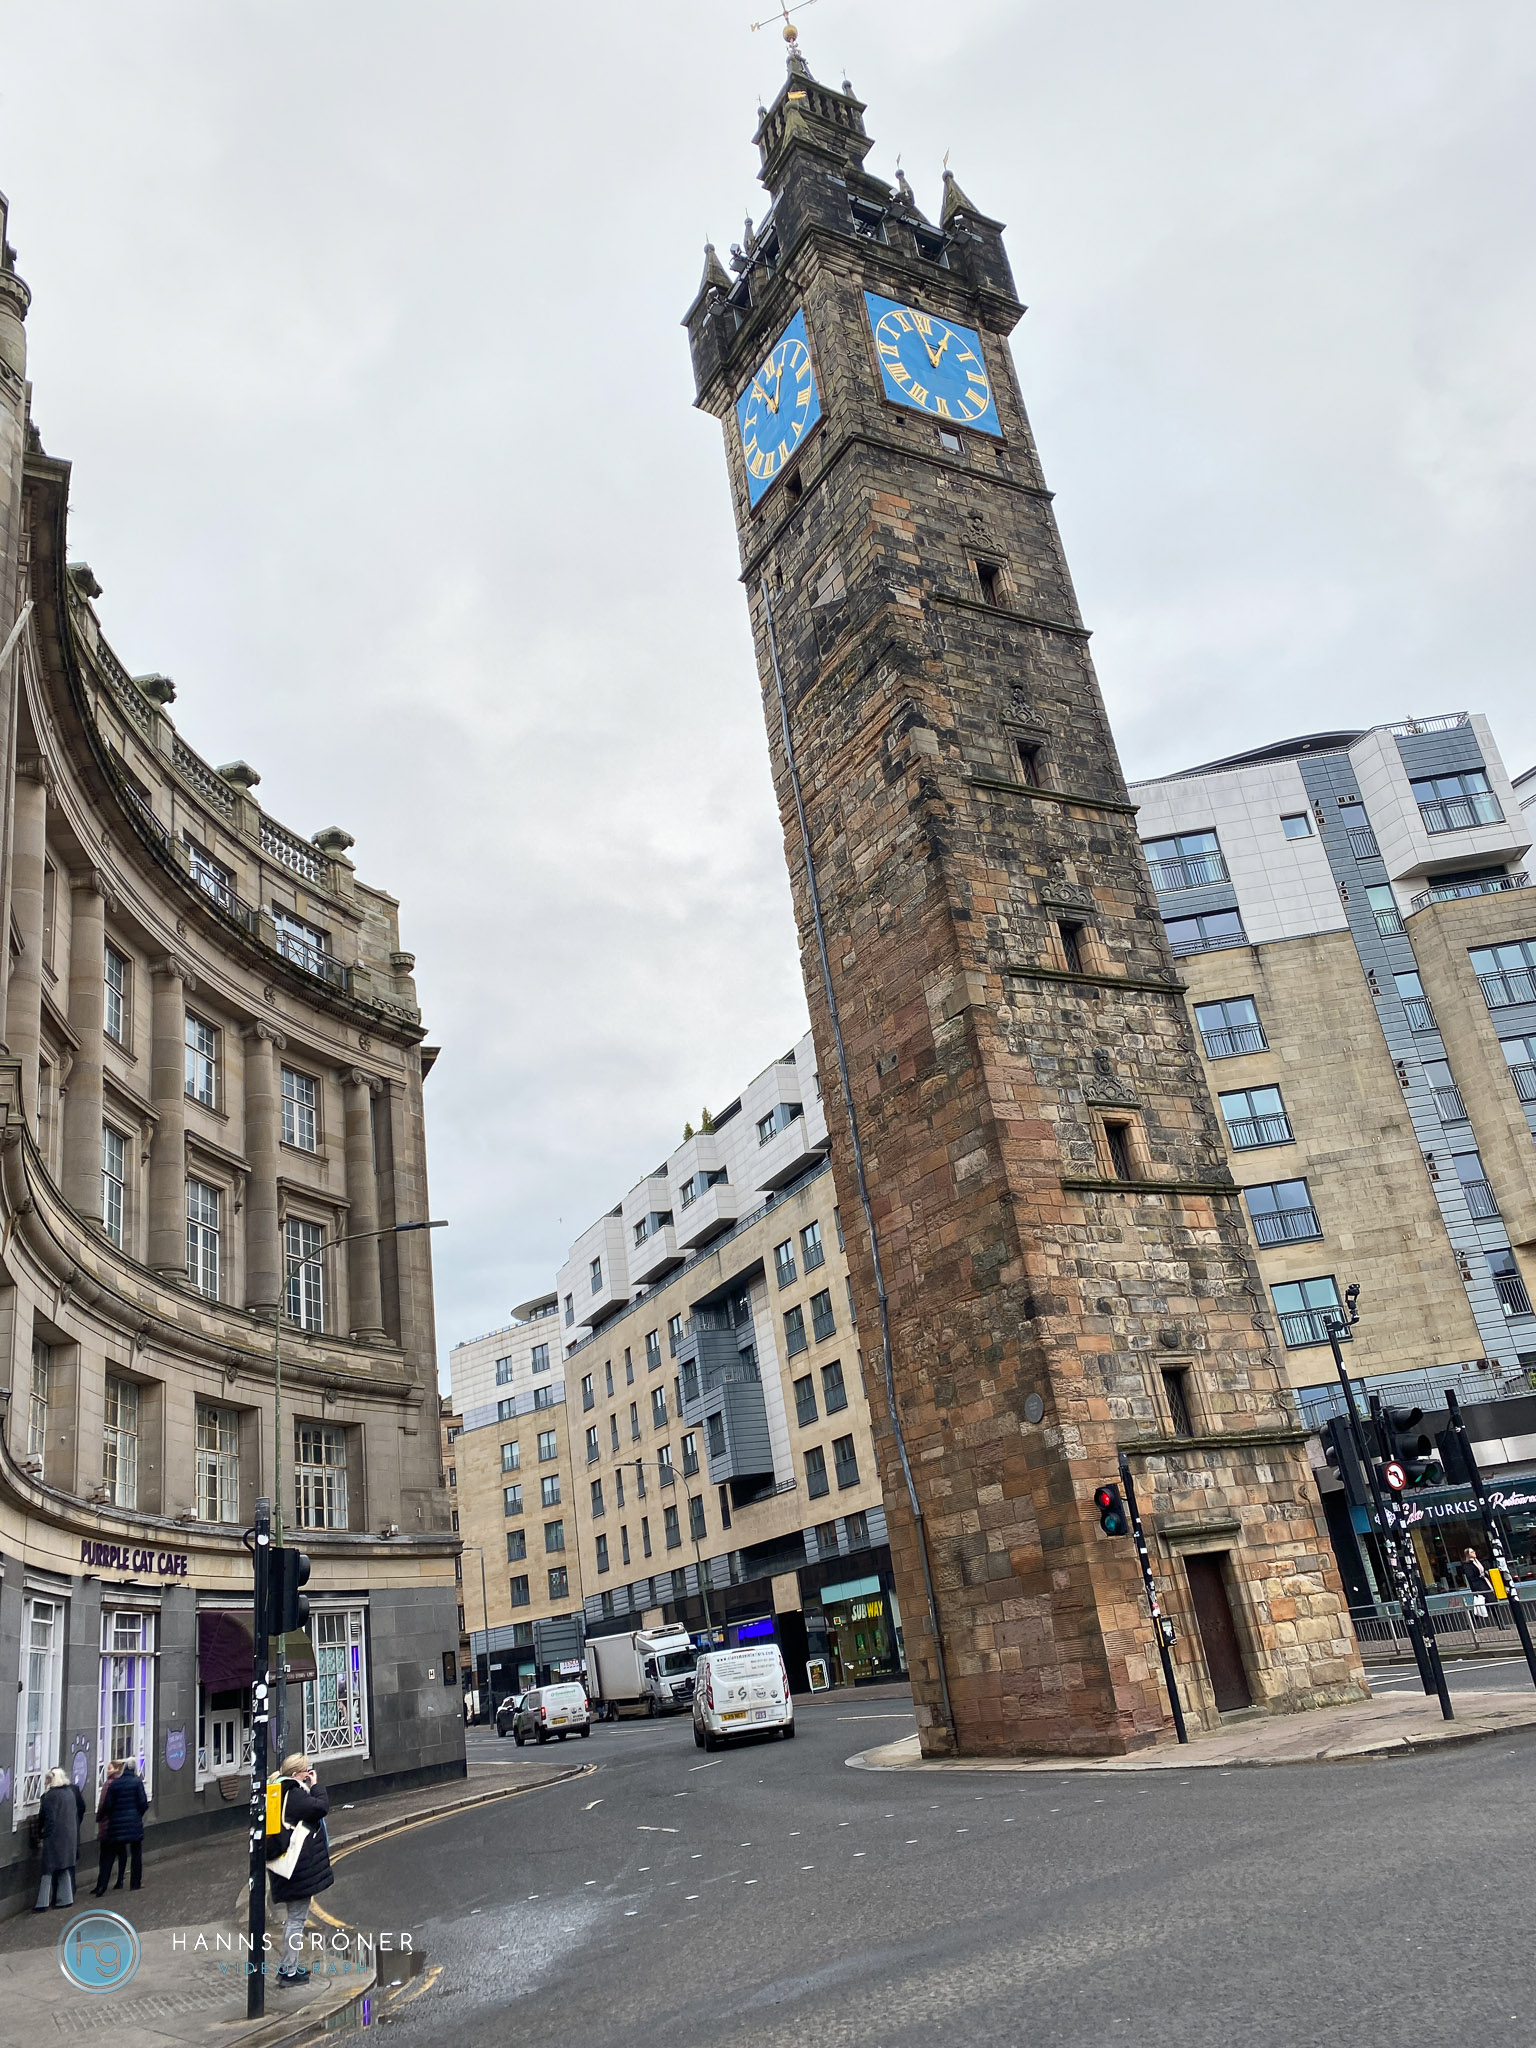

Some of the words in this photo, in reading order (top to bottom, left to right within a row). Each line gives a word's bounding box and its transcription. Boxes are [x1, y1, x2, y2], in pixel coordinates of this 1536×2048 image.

[880, 320, 901, 340] X
[892, 312, 914, 332] XI
[790, 344, 801, 369] II
[879, 339, 899, 358] IX
[956, 351, 975, 362] II
[966, 370, 987, 387] III
[935, 395, 952, 418] VI
[957, 399, 975, 419] V
[791, 421, 804, 438] V
[1425, 1500, 1478, 1518] TURKIS
[81, 1540, 130, 1570] PURRPLE
[132, 1549, 155, 1572] CAT
[158, 1552, 188, 1576] CAFE
[851, 1601, 883, 1621] SUBWAY
